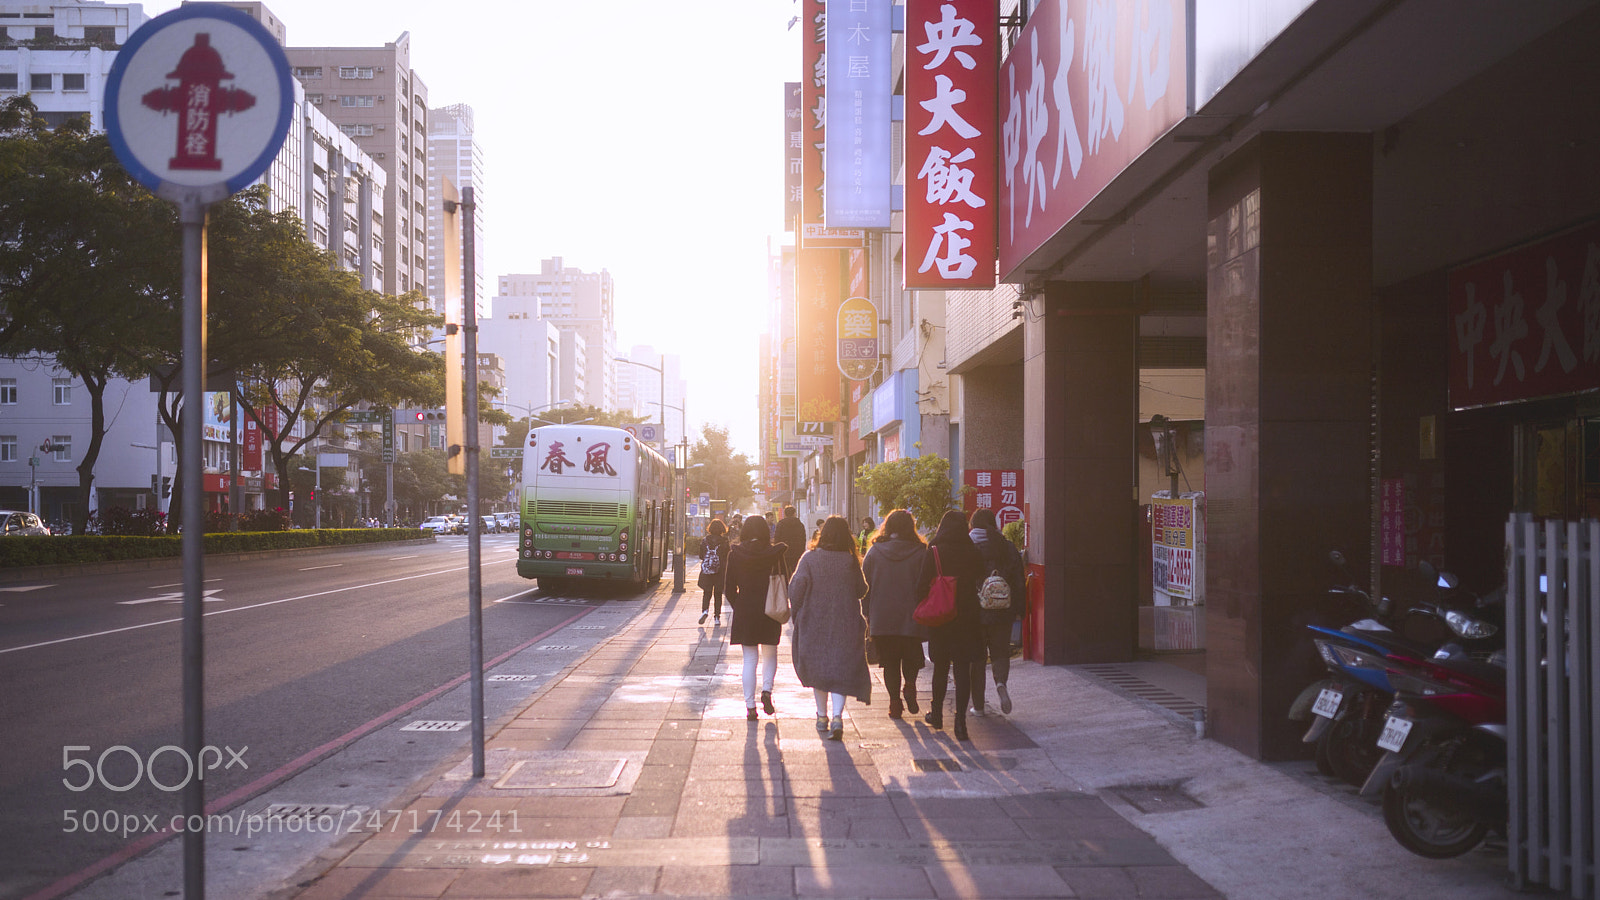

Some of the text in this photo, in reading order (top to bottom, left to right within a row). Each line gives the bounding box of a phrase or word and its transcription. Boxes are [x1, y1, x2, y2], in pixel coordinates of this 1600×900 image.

[184, 84, 211, 156] 消防栓
[915, 0, 985, 280] 央大飯店
[844, 309, 872, 337] 藥
[541, 441, 617, 477] 春風
[976, 472, 992, 508] 車輛
[550, 524, 604, 533] VOLVO
